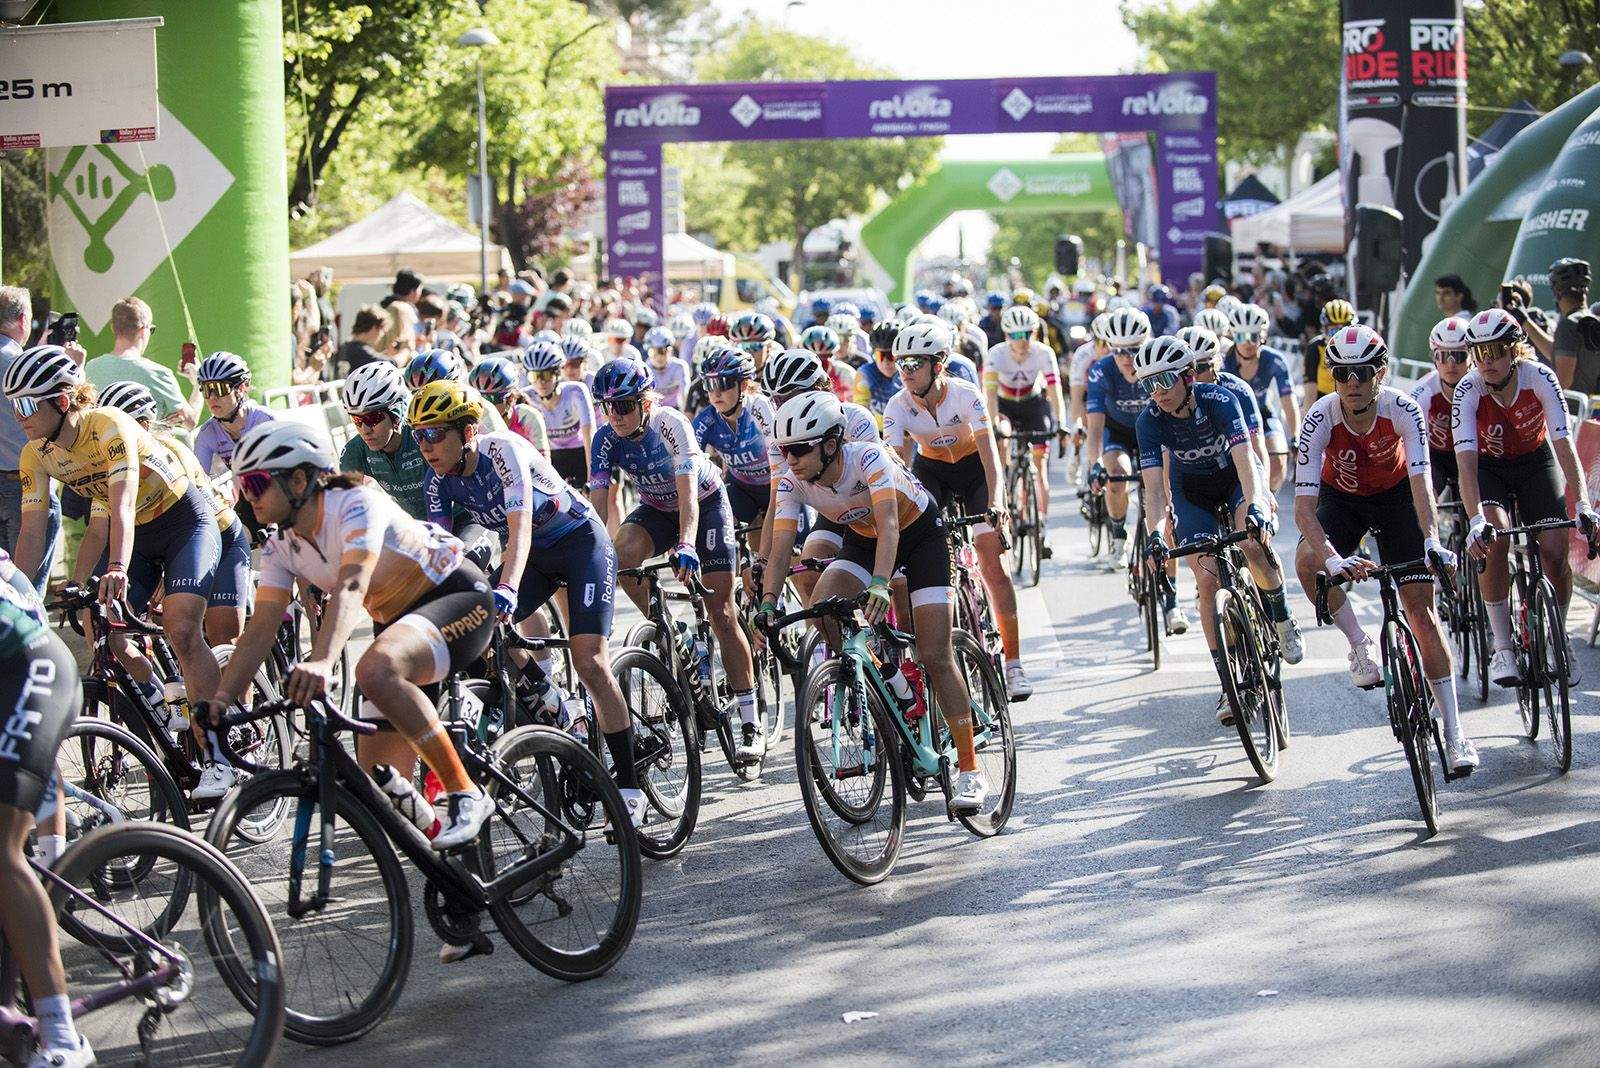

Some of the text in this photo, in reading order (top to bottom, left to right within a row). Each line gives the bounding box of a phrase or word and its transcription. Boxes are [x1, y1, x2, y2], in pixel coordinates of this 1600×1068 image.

[1346, 51, 1400, 80] IDE
[43, 82, 72, 97] m
[1201, 389, 1230, 403] wahoo
[108, 442, 126, 460] Buff
[171, 578, 201, 588] TACTIC
[601, 556, 615, 604] Roland
[1399, 574, 1436, 583] CORIMA
[213, 593, 240, 601] TACTIC
[442, 604, 489, 643] CYPRUS
